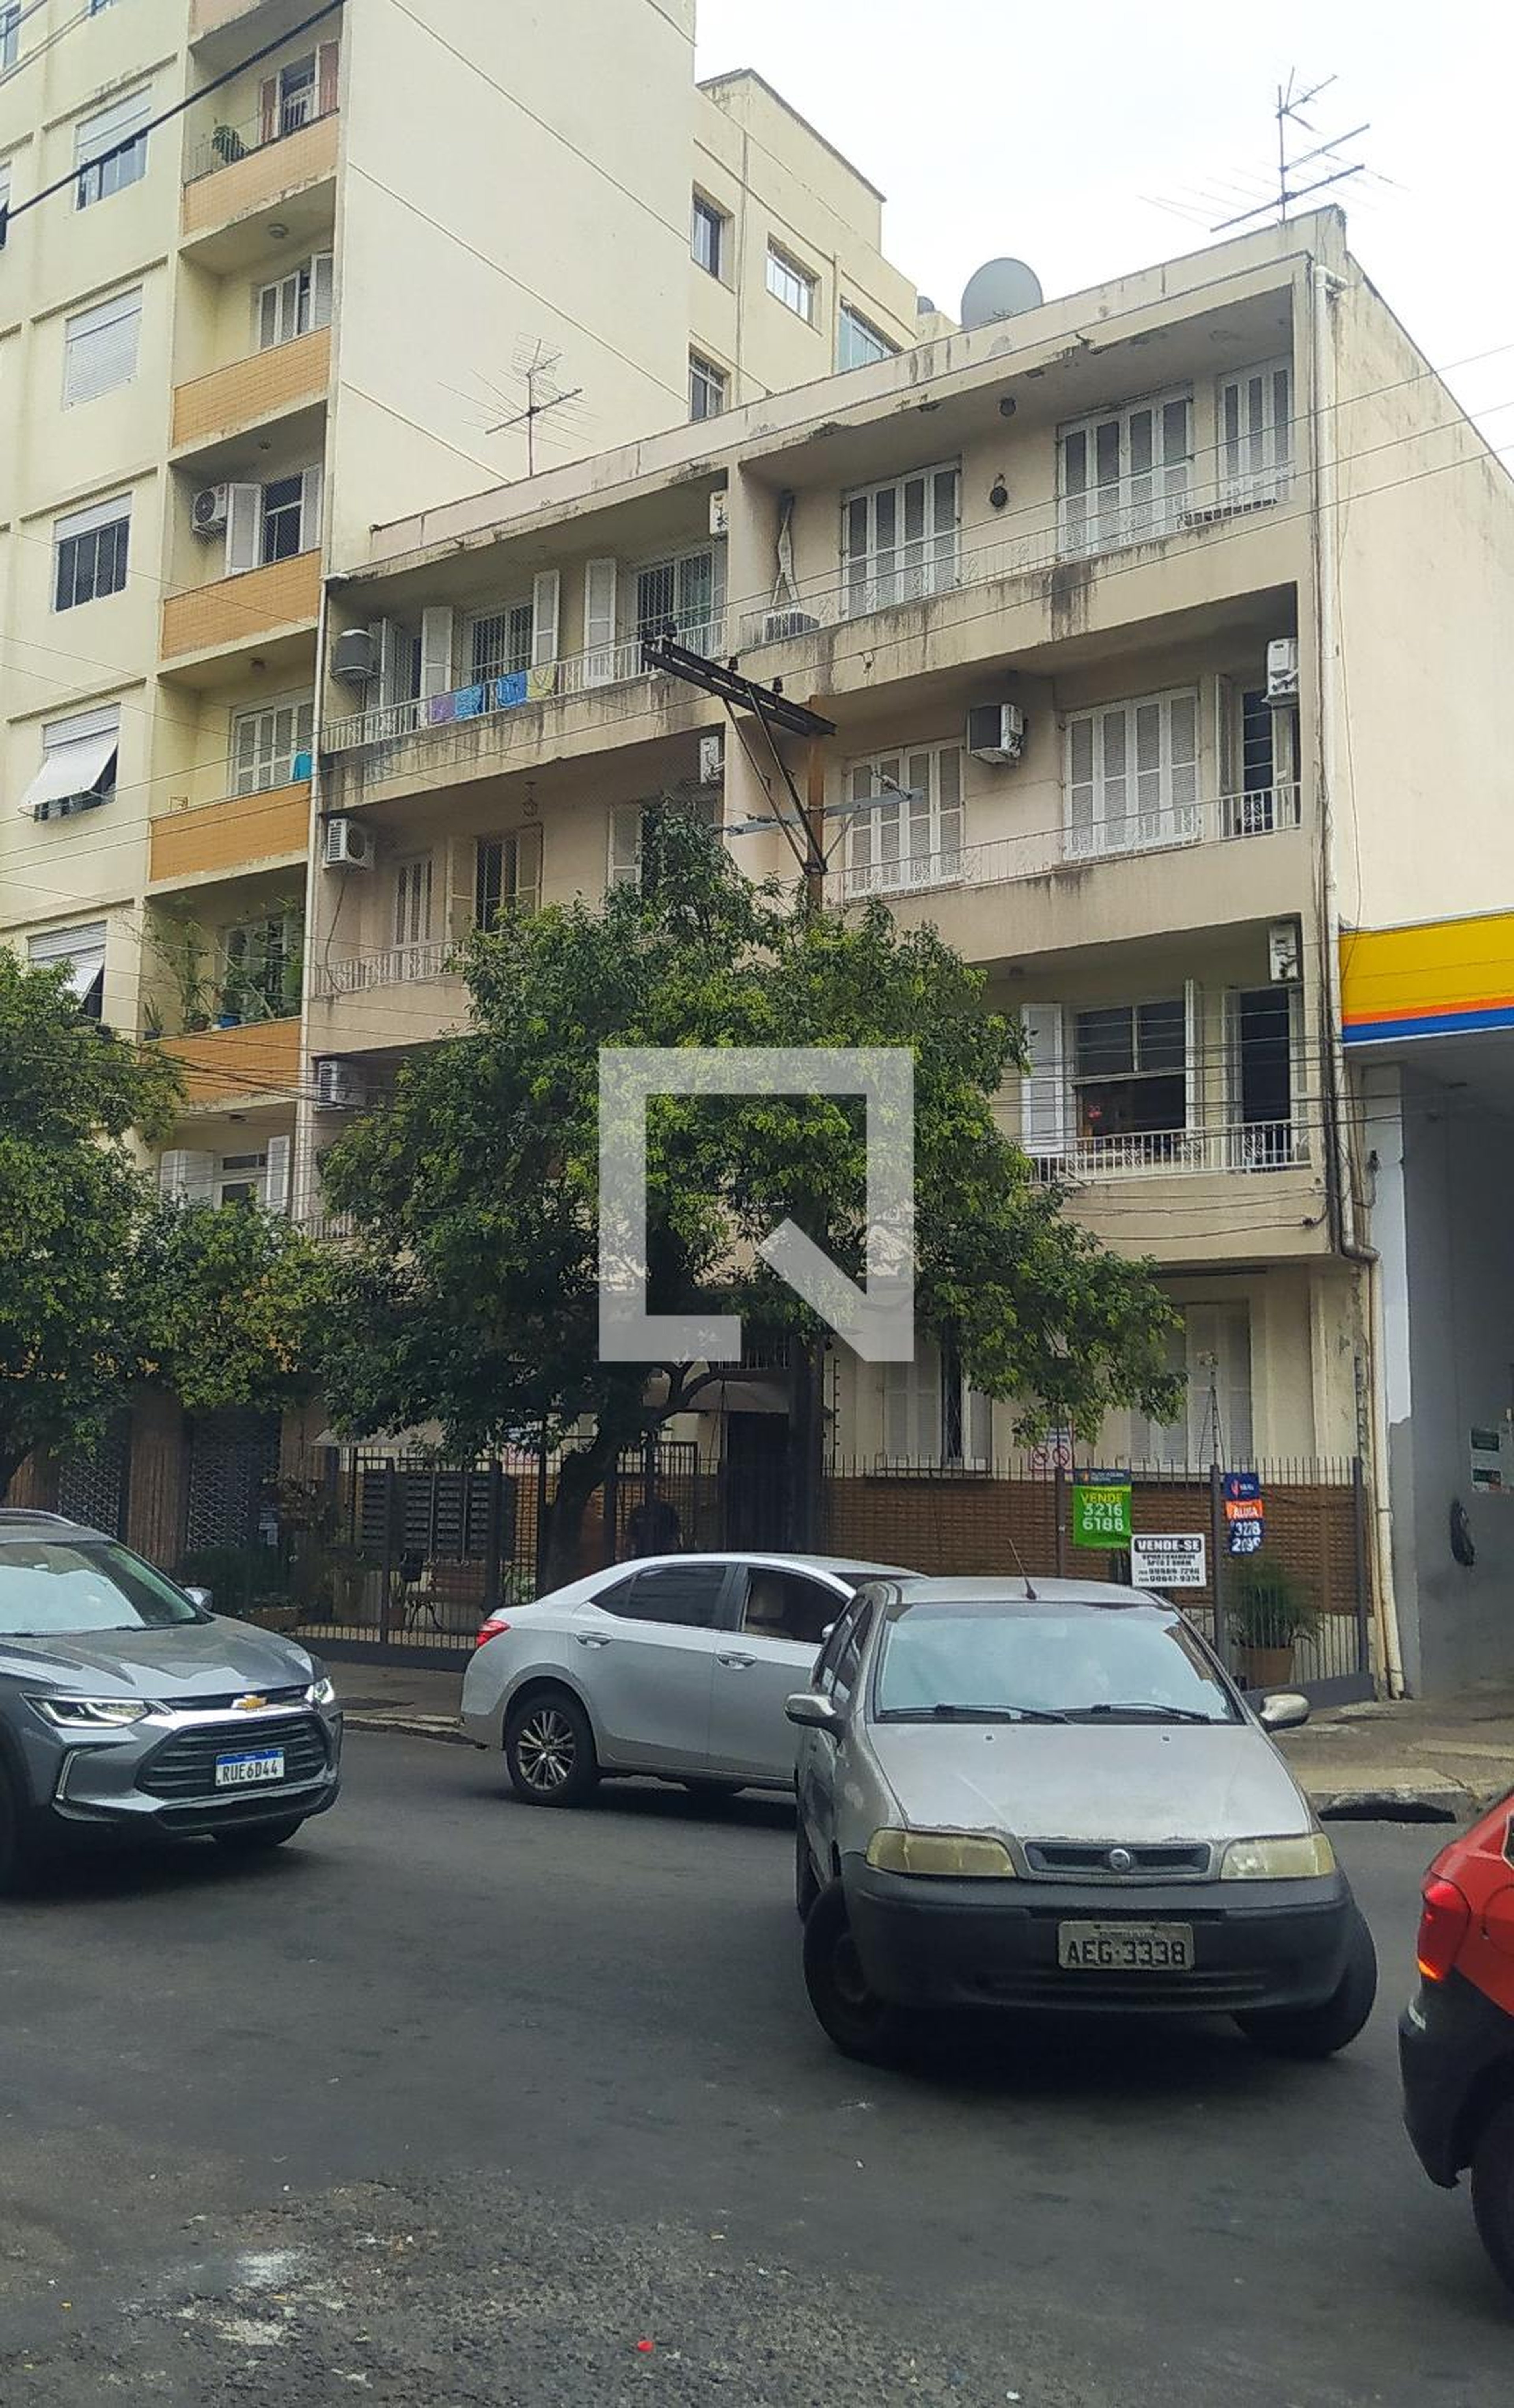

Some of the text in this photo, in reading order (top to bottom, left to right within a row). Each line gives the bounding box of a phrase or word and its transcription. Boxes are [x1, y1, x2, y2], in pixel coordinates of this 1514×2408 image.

[1080, 1491, 1123, 1505] VENDE
[1084, 1503, 1123, 1516] 3216
[1137, 1540, 1200, 1551] VENDE-SE
[223, 1760, 277, 1782] RUE6D44
